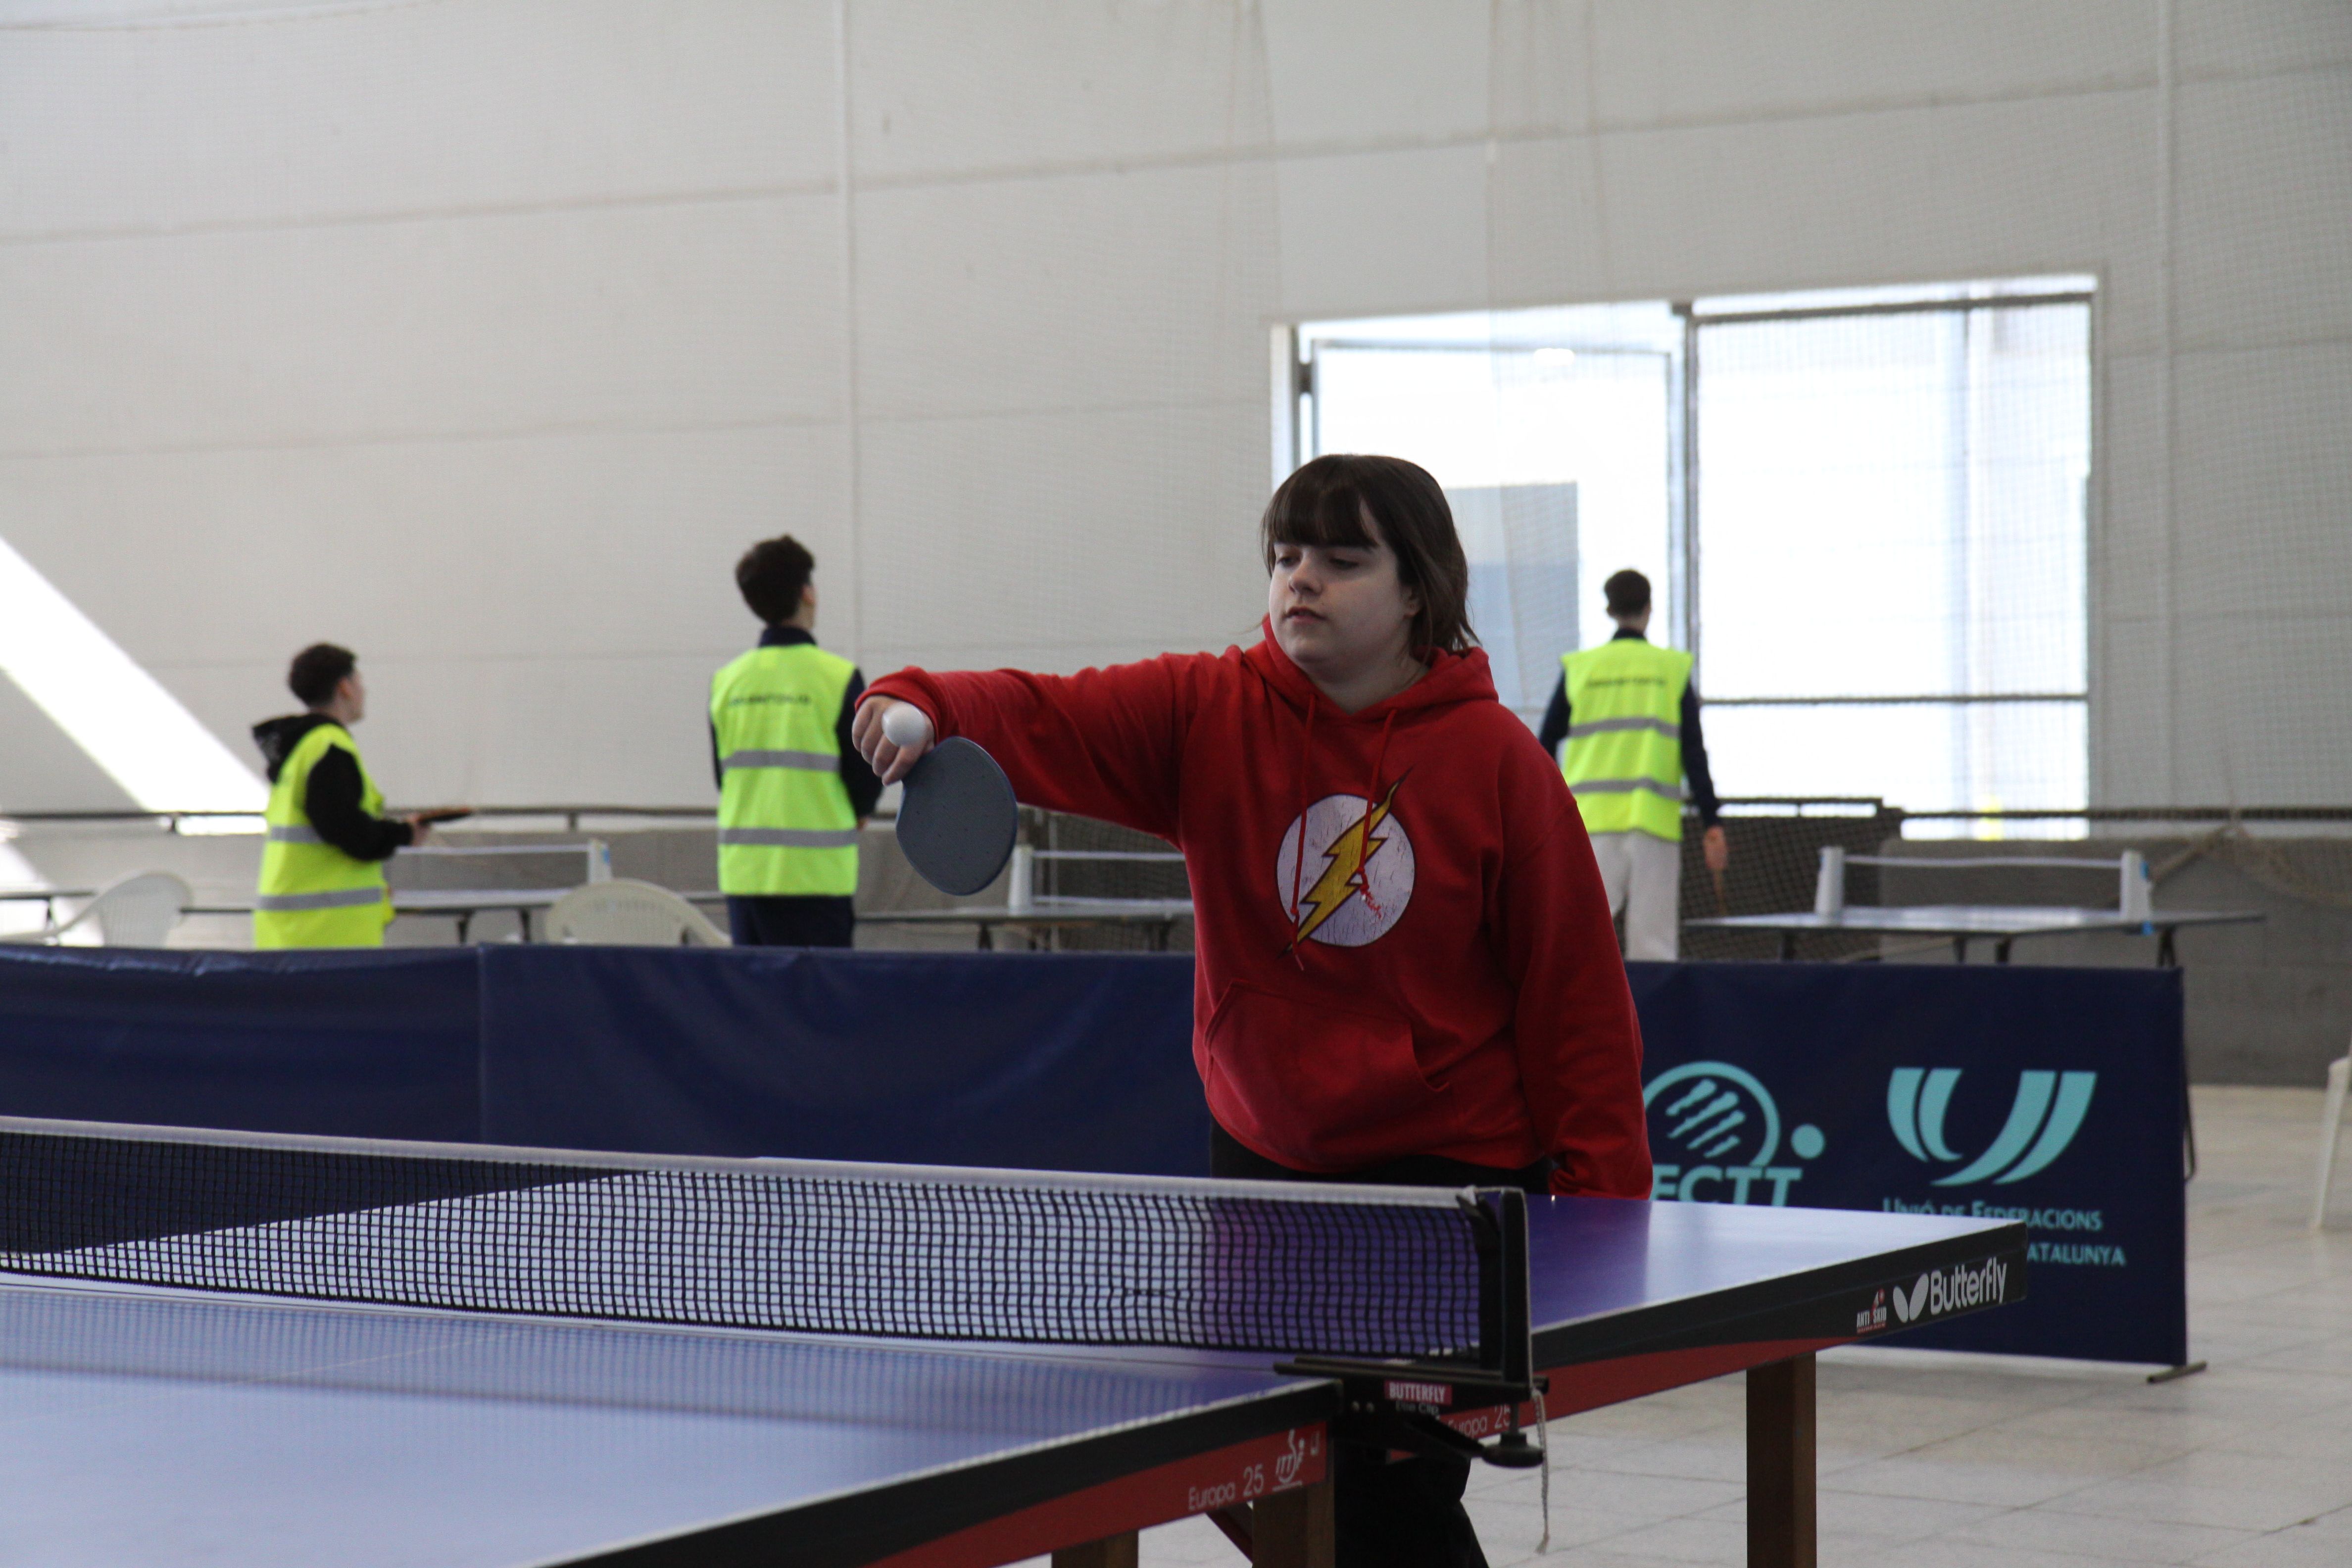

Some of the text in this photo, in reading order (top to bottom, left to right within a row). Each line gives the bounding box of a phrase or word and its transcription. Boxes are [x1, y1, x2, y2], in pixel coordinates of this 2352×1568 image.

[2027, 1242, 2127, 1267] ATALUNYA
[1930, 1256, 2007, 1315] Butterfly
[1857, 1306, 1887, 1327] ANTI SKID
[1389, 1381, 1445, 1403] BUTTERFLY
[1448, 1416, 1487, 1438] ropa
[1188, 1482, 1235, 1510] Europa
[1243, 1463, 1264, 1497] 25
